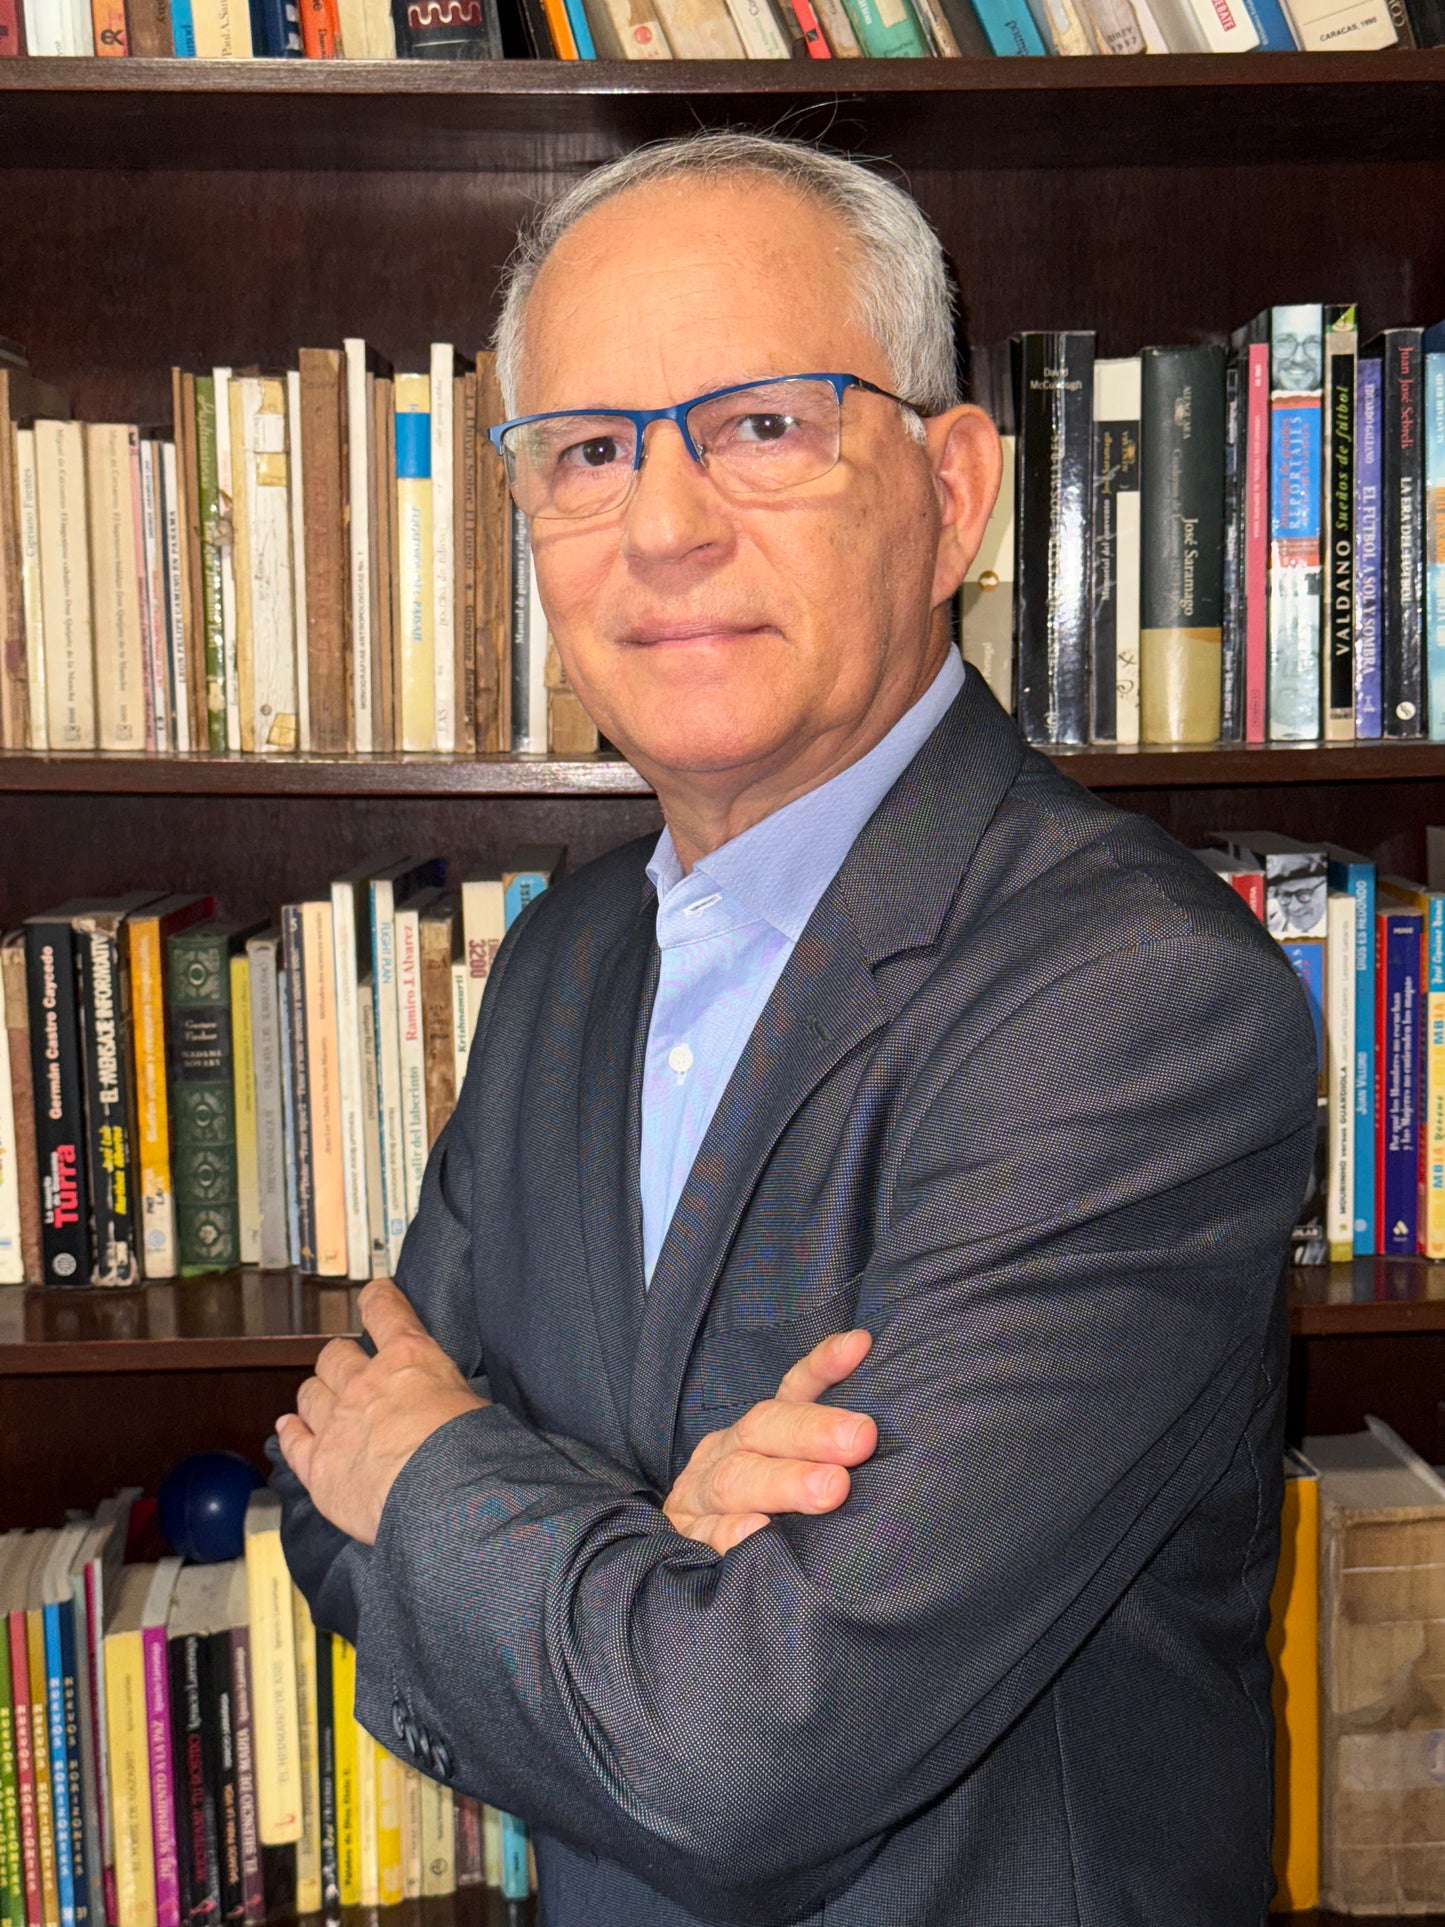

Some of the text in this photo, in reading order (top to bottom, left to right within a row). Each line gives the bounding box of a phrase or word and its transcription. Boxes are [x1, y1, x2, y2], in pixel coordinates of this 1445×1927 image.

[1043, 368, 1068, 377] David
[1364, 384, 1375, 424] EDUARDO
[1364, 425, 1375, 464] GALEANO
[1398, 347, 1414, 546] Juan José Sebreli LA ERA DEL
[1362, 486, 1376, 503] EL
[1335, 385, 1351, 656] VALDANO Sueños de fútbol
[516, 561, 526, 594] pintura
[1179, 518, 1199, 616] José Saramago
[1364, 565, 1375, 573] A
[515, 597, 524, 608] de
[1363, 576, 1375, 603] SOL
[515, 610, 524, 644] Manual
[1363, 606, 1375, 616] Y
[1362, 618, 1375, 675] SOMBRA
[1356, 881, 1367, 929] REDONDO
[381, 922, 392, 984] FLIGHT PLAN
[469, 939, 488, 978] 3200
[1356, 932, 1367, 944] ES
[1356, 946, 1367, 971] DIOS
[404, 978, 414, 987] J.
[1402, 977, 1414, 1008] mapas
[40, 946, 62, 1119] Germán Castro Caycedo
[404, 990, 418, 1041] Ramiro
[455, 975, 466, 1053] Krishnamurti
[1390, 993, 1400, 1037] escuchan
[95, 1020, 119, 1104] EL MENSAJE
[1392, 1039, 1400, 1052] no
[1402, 1026, 1411, 1073] entienden
[408, 1066, 420, 1126] laberinto
[1390, 1054, 1400, 1097] Hombres
[1403, 1075, 1411, 1087] no
[1390, 1114, 1401, 1132] qué
[1401, 1089, 1412, 1126] Mujeres
[349, 1112, 357, 1145] Harcourt
[410, 1129, 421, 1148] del
[1390, 1134, 1400, 1151] Por
[53, 1144, 78, 1228] Turra
[352, 1171, 360, 1215] Jovanovich
[0, 1707, 13, 1773] NUEVOS
[151, 1720, 165, 1741] PAZ
[152, 1743, 166, 1758] LA
[33, 1702, 53, 1890] NUEVOS HORIZONTES
[50, 1677, 69, 1876] NUEVOS HORIZONTES
[64, 1676, 84, 1876] NUEVOS HORIZONTES
[15, 1704, 36, 1893] NUEVOS HORIZONTES
[155, 1773, 171, 1854] SUFRIMIENTO
[5, 1786, 21, 1896] HORIZONTES
[240, 1772, 258, 1873] EL SILENCIO DE
